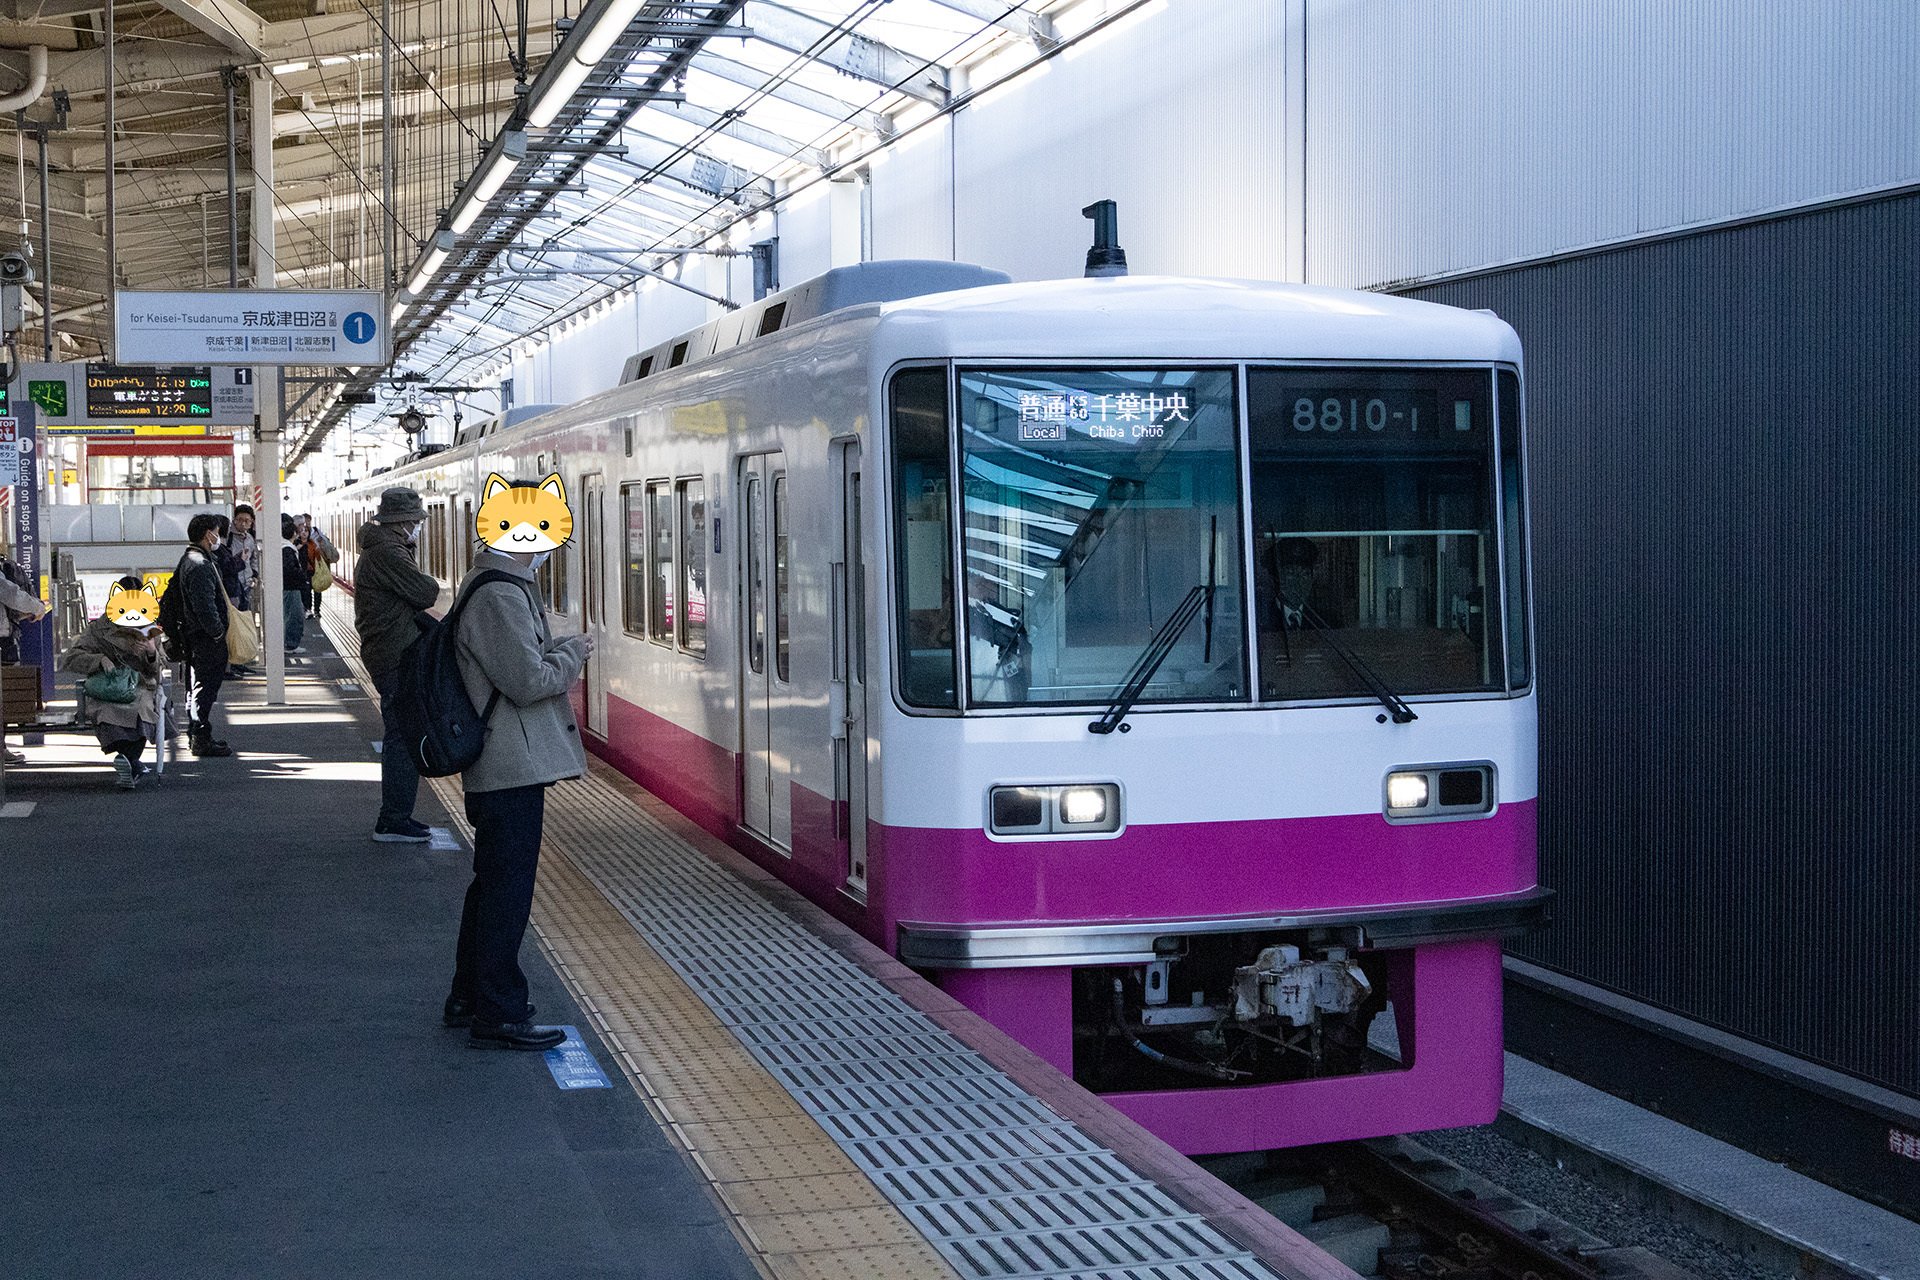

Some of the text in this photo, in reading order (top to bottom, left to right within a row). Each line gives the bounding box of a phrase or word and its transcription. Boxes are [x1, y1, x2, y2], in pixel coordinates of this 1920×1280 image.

[130, 313, 239, 323] for Keisei-Tsudanuma
[242, 311, 326, 327] 京成津田沼
[353, 317, 363, 339] 1
[205, 336, 244, 346] 京成千葉
[251, 336, 288, 346] 新津田沼
[294, 336, 331, 346] 北習志野
[238, 369, 246, 384] 1
[1019, 394, 1066, 421] 普通
[1069, 396, 1088, 407] KS
[1091, 392, 1190, 422] 千葉中央
[1069, 408, 1088, 420] 60
[1292, 398, 1418, 432] 8810-1
[1023, 425, 1060, 439] Local
[1090, 425, 1125, 438] Chiba
[20, 458, 31, 487] Guide
[21, 490, 30, 502] on
[21, 506, 31, 532] stops
[22, 534, 33, 543] &
